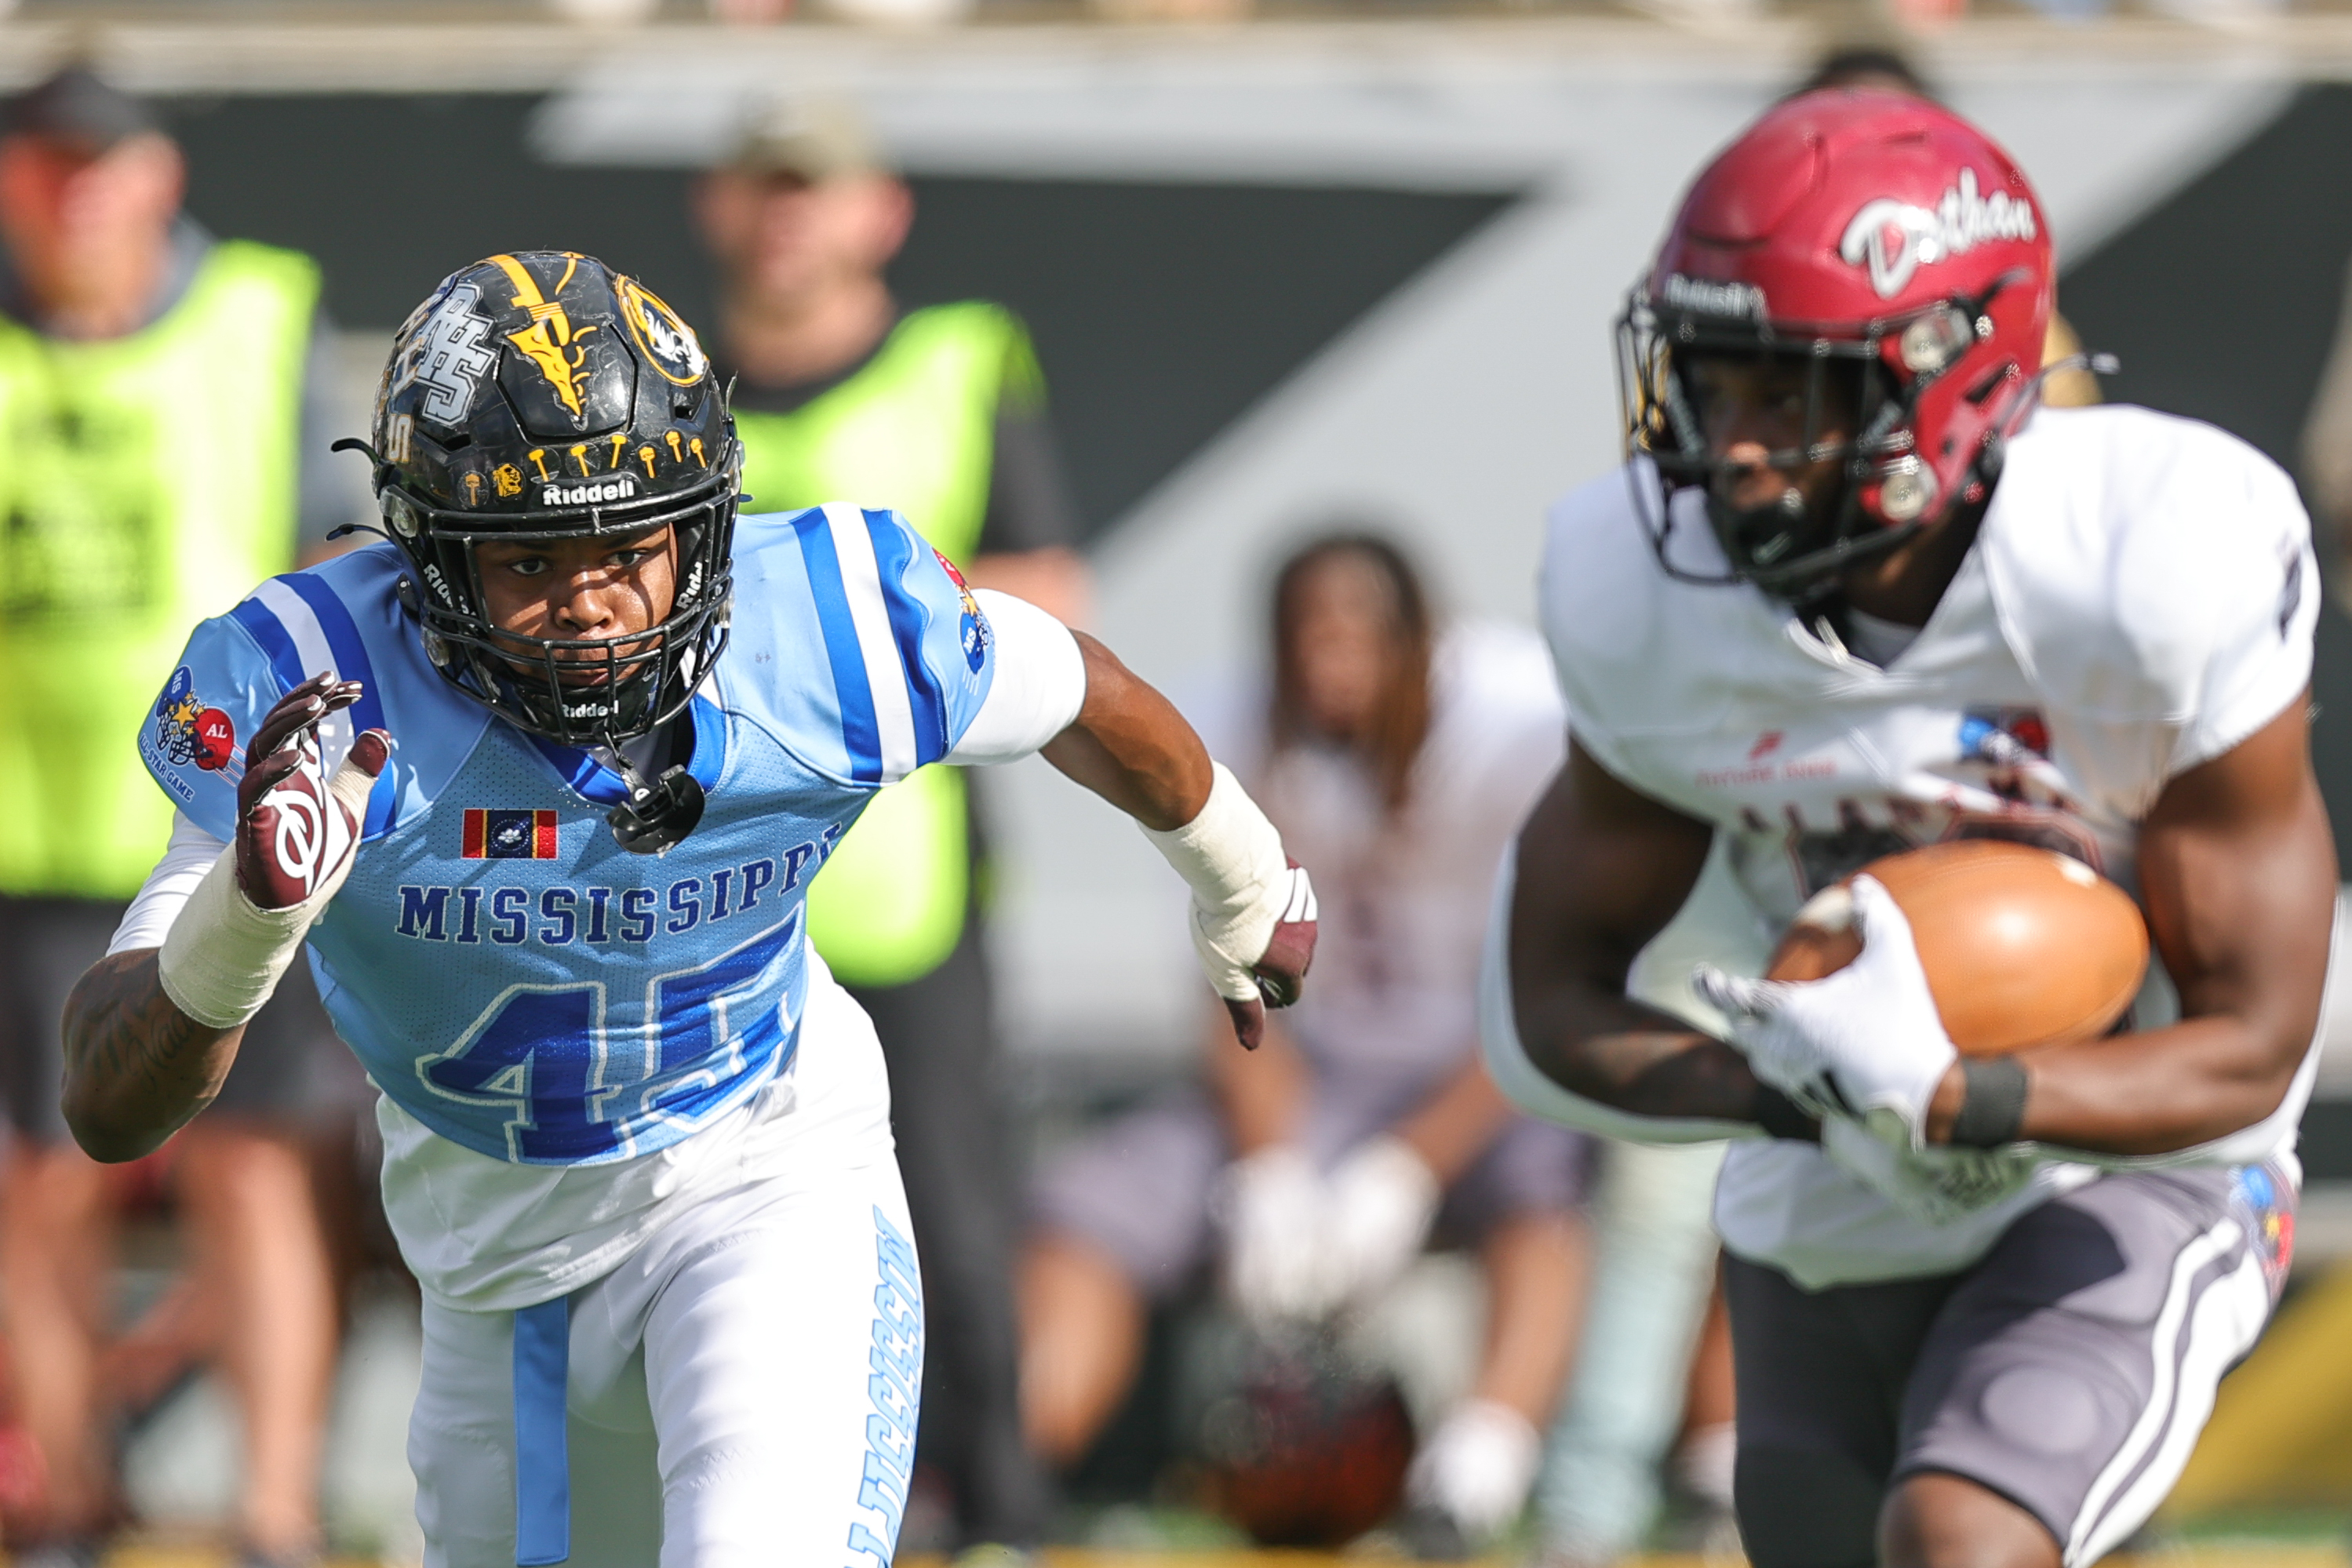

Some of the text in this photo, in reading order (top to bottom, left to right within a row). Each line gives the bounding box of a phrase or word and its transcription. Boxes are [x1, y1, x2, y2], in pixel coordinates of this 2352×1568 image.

[542, 479, 634, 506] Riddell
[171, 669, 184, 694] MS
[206, 723, 228, 739] AL
[166, 769, 195, 802] GAME
[415, 899, 804, 1166] 45
